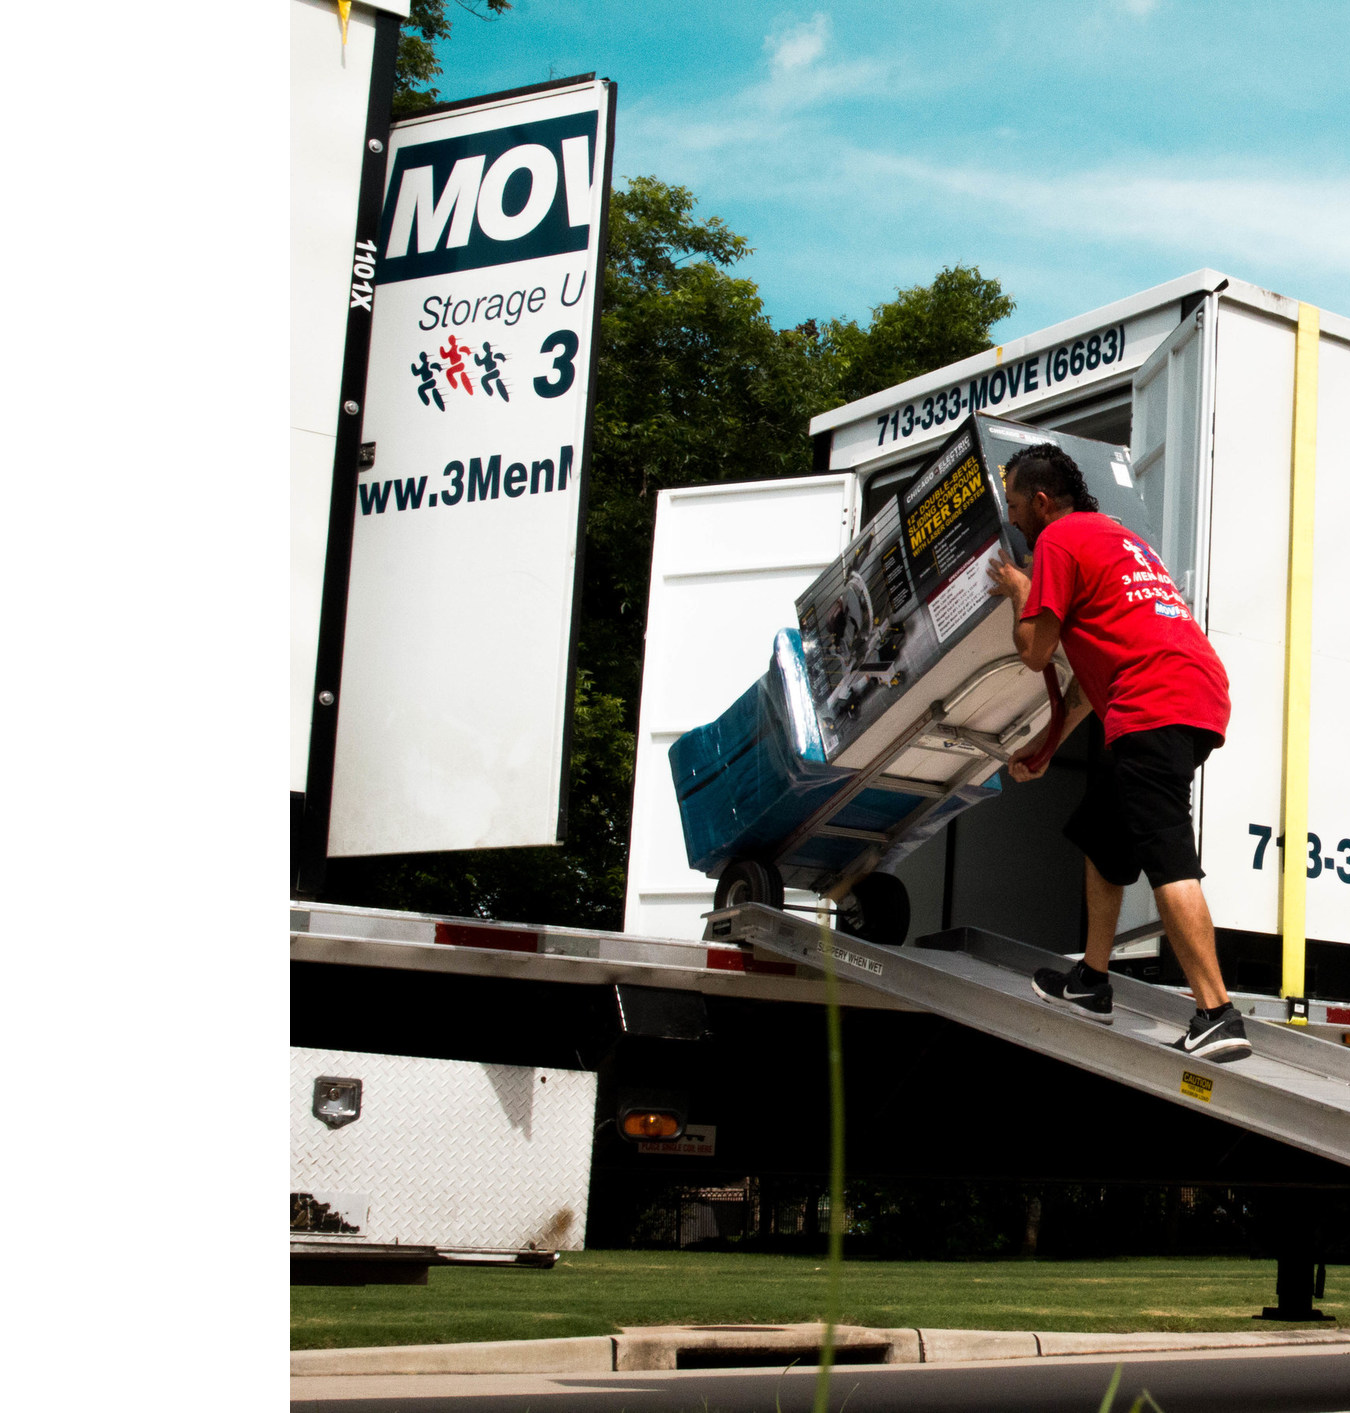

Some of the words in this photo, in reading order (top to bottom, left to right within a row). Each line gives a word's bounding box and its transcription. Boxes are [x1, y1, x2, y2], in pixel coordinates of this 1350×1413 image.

[350, 239, 377, 312] 1101X
[418, 287, 547, 331] Storage
[533, 329, 579, 399] 3
[877, 357, 1040, 446] 713-333-MOVE
[1046, 324, 1126, 387] (6683)
[906, 471, 935, 504] CHICAGO
[937, 435, 970, 471] ELECTRIC
[908, 505, 937, 537] SLIDING
[937, 463, 980, 508] COMPOUND
[910, 504, 952, 551] MITER
[952, 472, 982, 509] SAW
[912, 540, 927, 558] WITH
[926, 524, 946, 545] LASER
[945, 508, 963, 527] GUIDE
[962, 484, 986, 511] SYSTEM
[1121, 574, 1132, 585] 3
[848, 952, 867, 968] WHEN
[868, 960, 883, 974] WET
[1183, 1073, 1212, 1090] CAUTION
